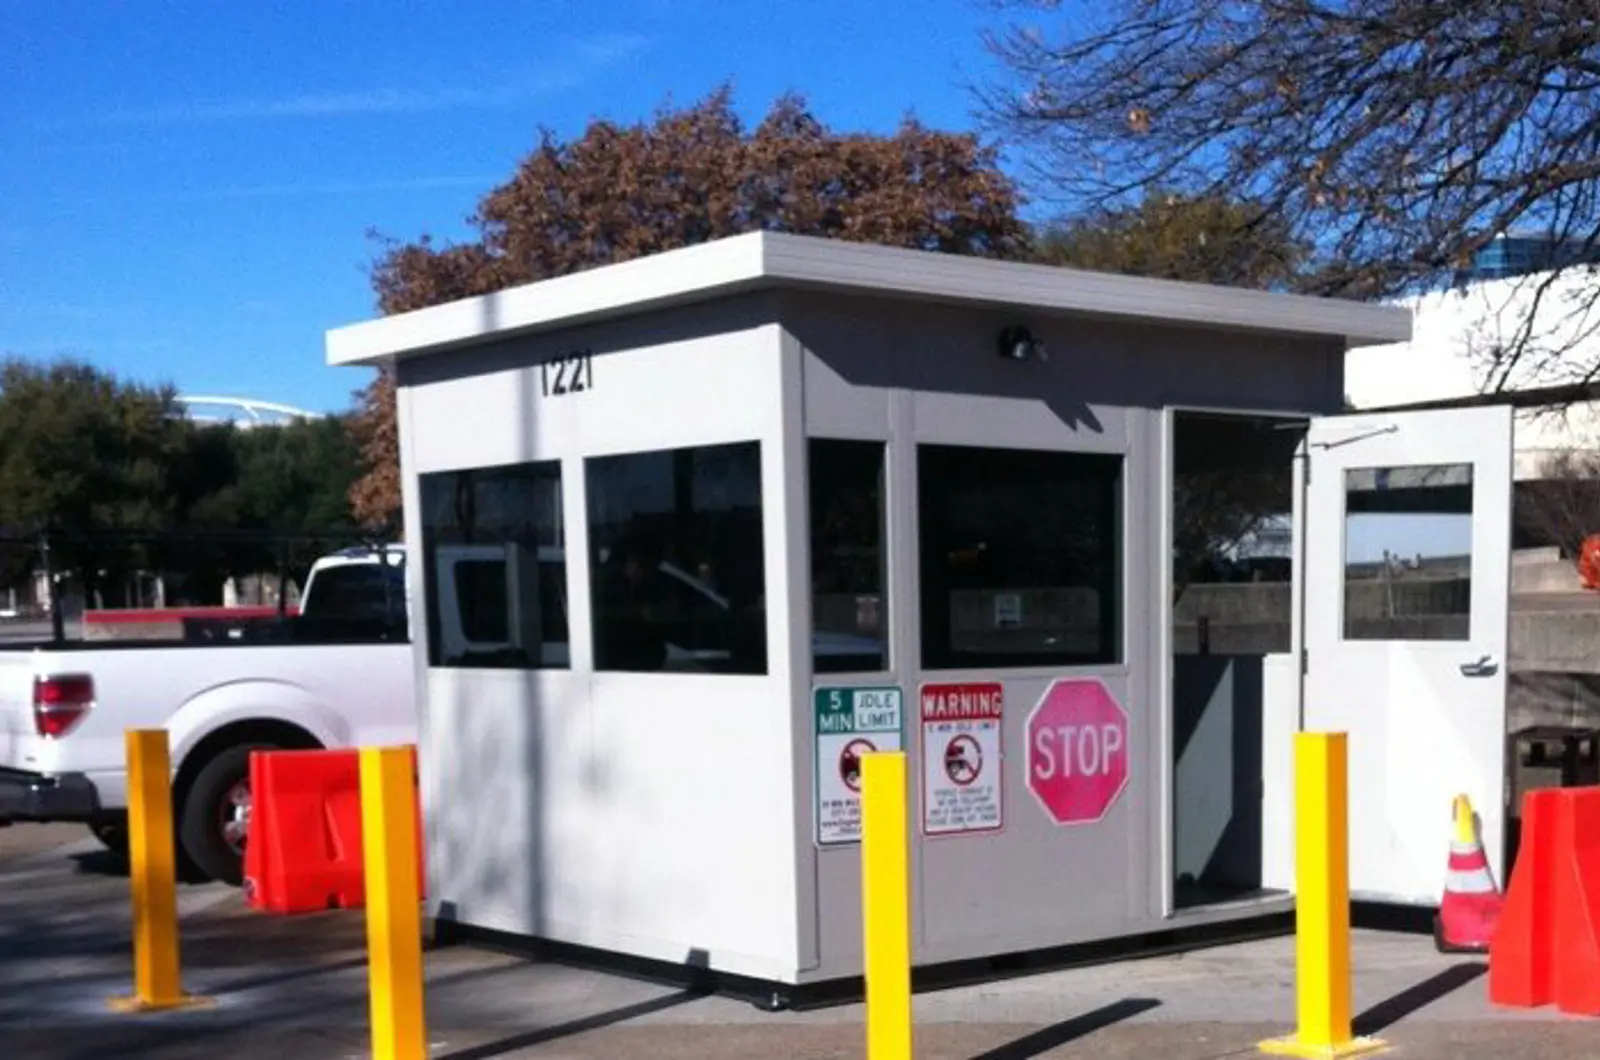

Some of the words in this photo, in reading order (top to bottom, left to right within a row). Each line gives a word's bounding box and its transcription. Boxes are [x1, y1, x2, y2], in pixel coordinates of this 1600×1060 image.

[541, 349, 592, 397] 1221
[830, 690, 842, 710] 5
[859, 693, 894, 708] IDLE
[922, 691, 1002, 717] WARNING
[819, 713, 853, 731] MIN
[858, 711, 896, 728] LIMIT
[1035, 724, 1123, 780] STOP
